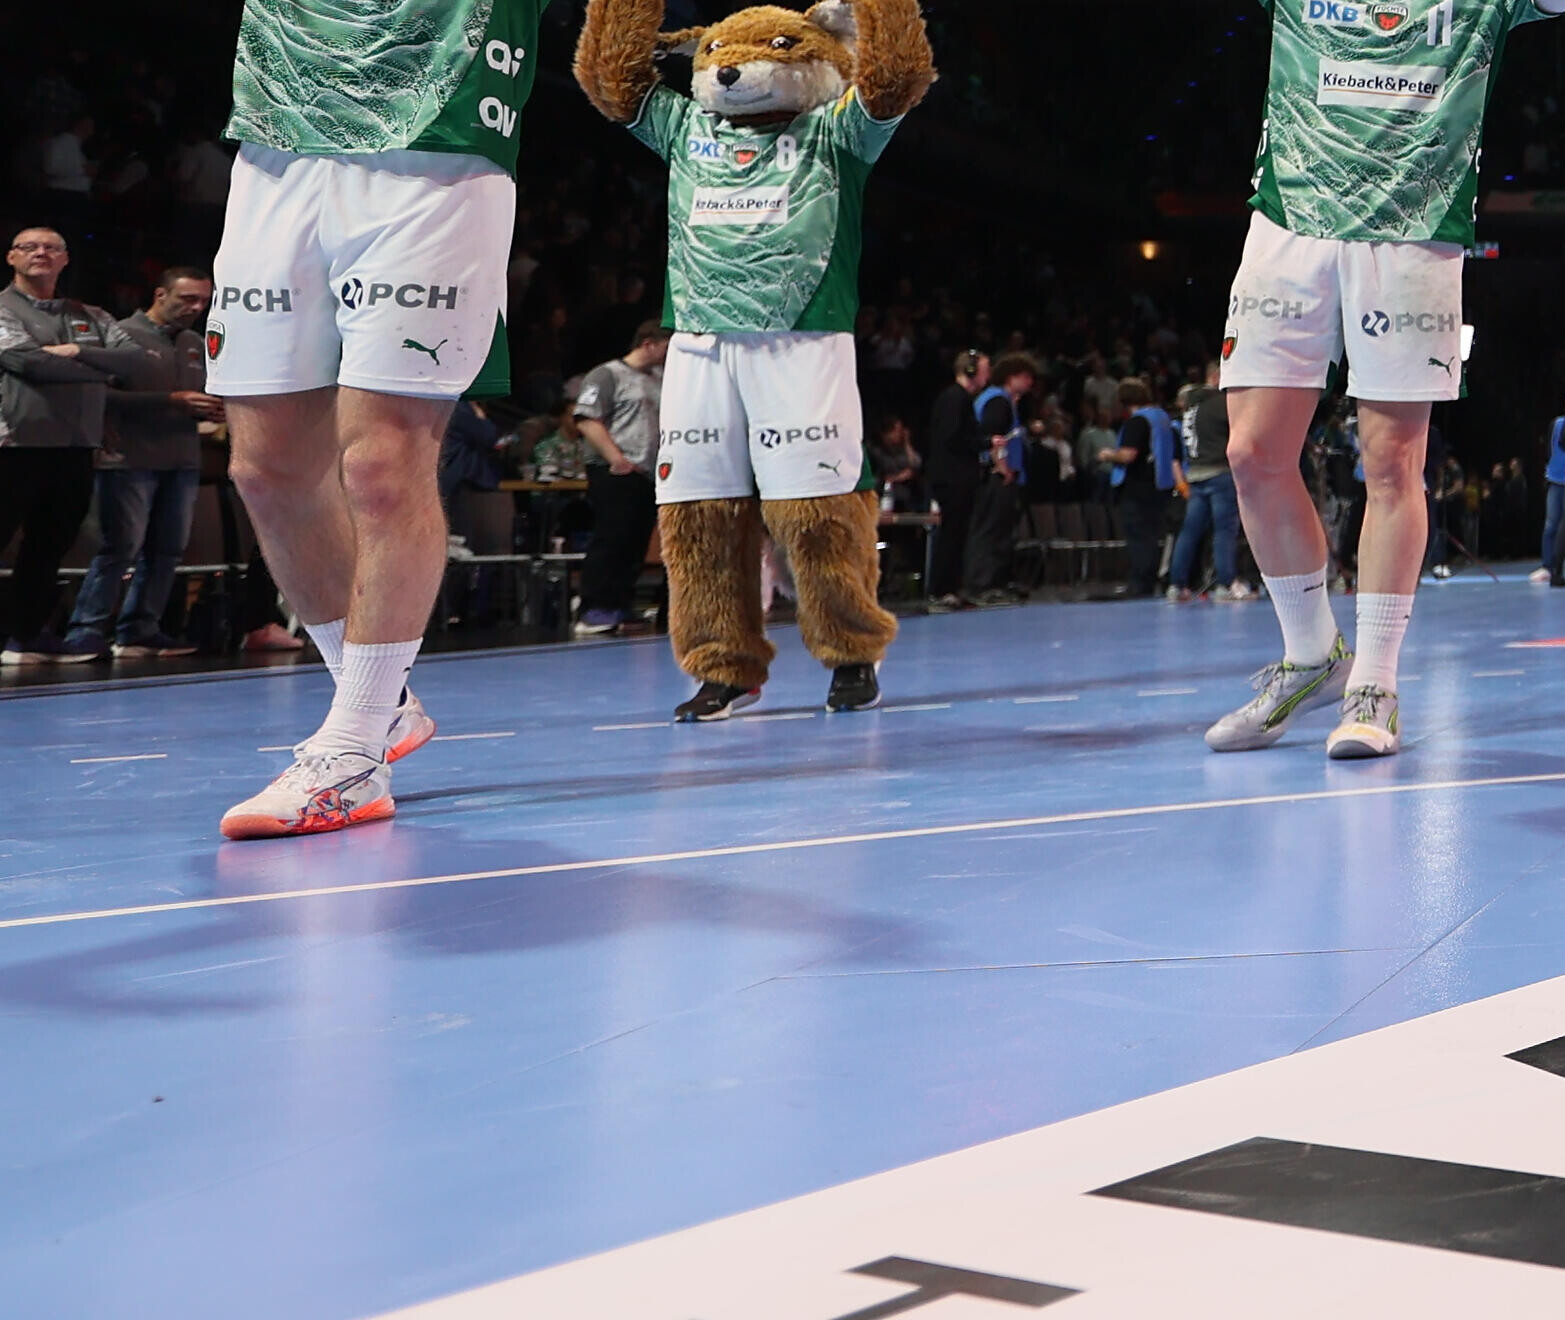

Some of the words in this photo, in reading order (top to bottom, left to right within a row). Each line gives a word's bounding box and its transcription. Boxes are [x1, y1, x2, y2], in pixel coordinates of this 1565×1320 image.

[1308, 0, 1359, 22] DKB
[1426, 0, 1454, 47] 11
[1323, 72, 1439, 95] Kieback&Peter
[775, 134, 798, 173] 8
[1241, 298, 1303, 319] PCH
[1395, 312, 1456, 332] PCH
[668, 429, 720, 445] PCH
[786, 424, 839, 444] PCH
